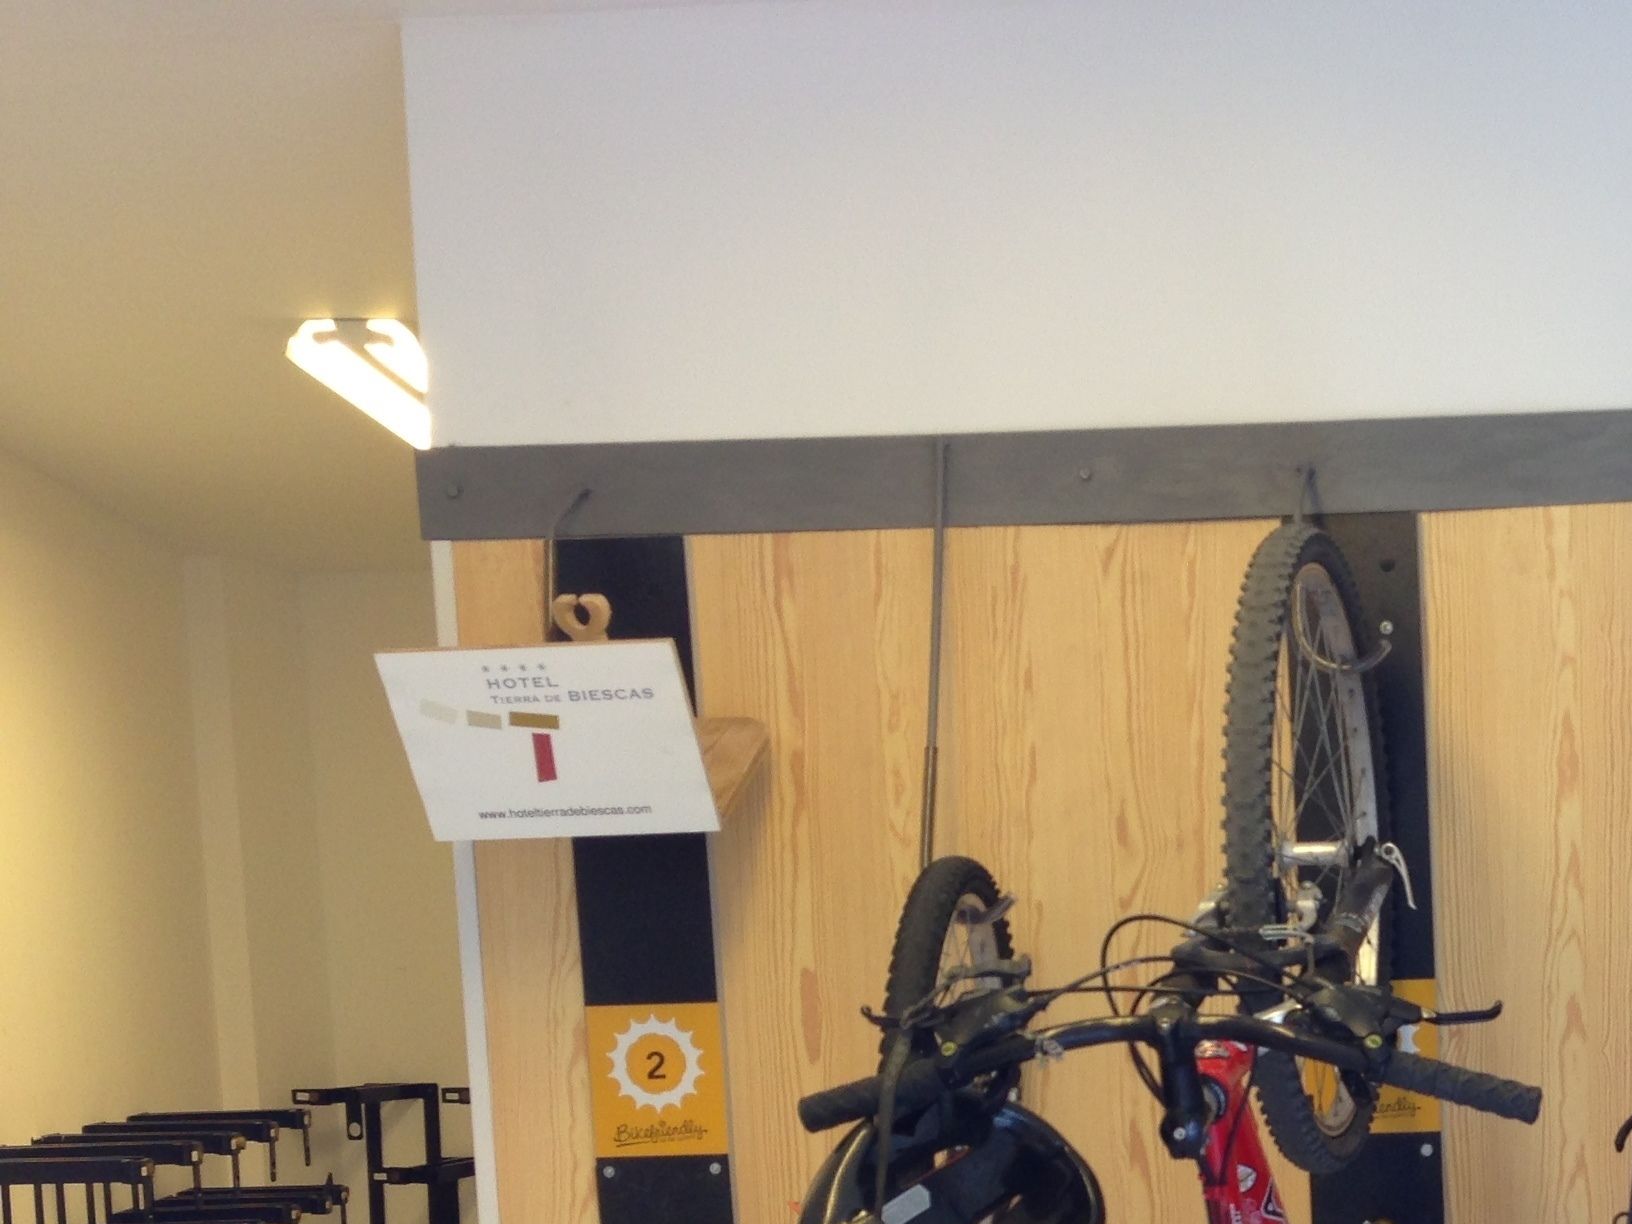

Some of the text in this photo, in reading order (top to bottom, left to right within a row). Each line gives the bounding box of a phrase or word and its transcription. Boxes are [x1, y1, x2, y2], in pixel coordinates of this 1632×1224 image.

[486, 677, 559, 689] HOTEL
[567, 687, 655, 702] BIESCAS
[646, 1051, 666, 1080] 2
